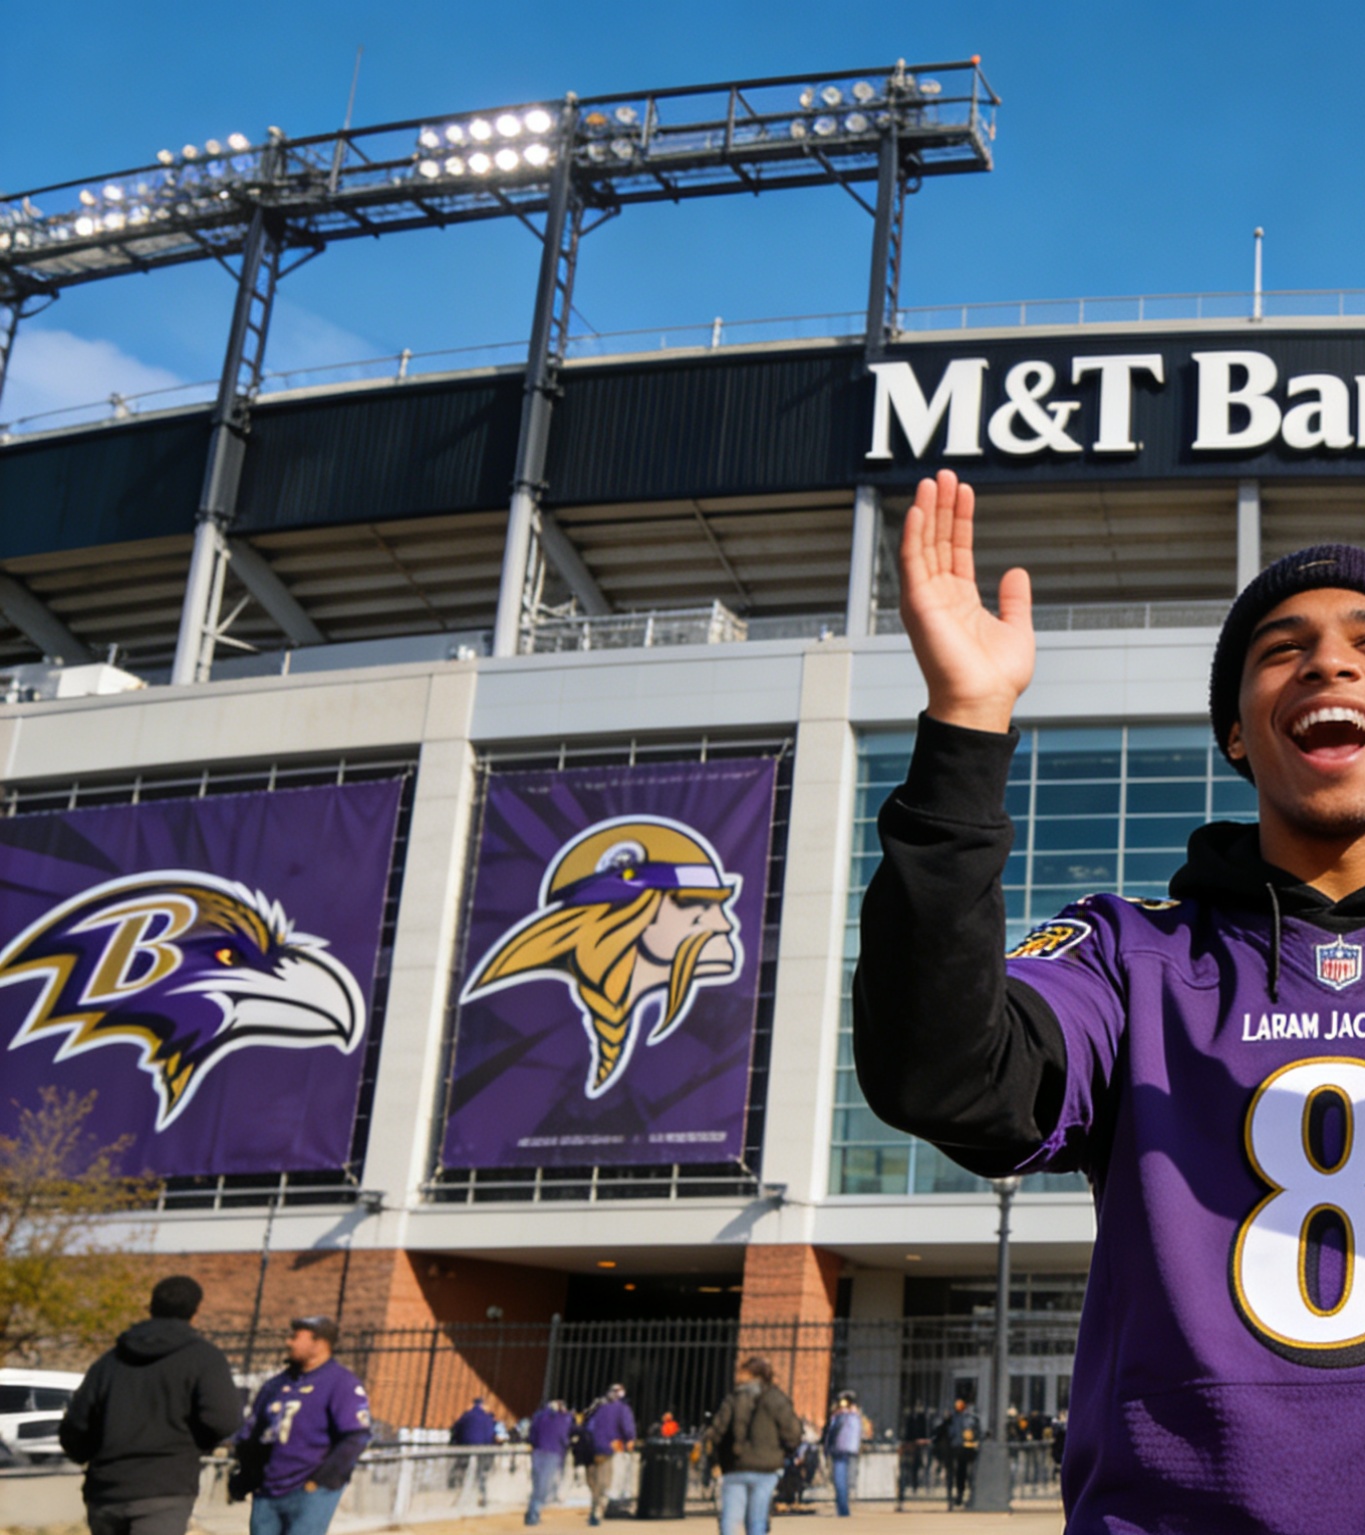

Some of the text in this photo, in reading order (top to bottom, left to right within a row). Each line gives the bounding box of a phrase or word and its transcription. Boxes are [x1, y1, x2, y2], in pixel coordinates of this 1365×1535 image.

[865, 354, 1165, 460] M&T
[65, 894, 200, 1006] B
[1241, 1012, 1320, 1042] LARAM
